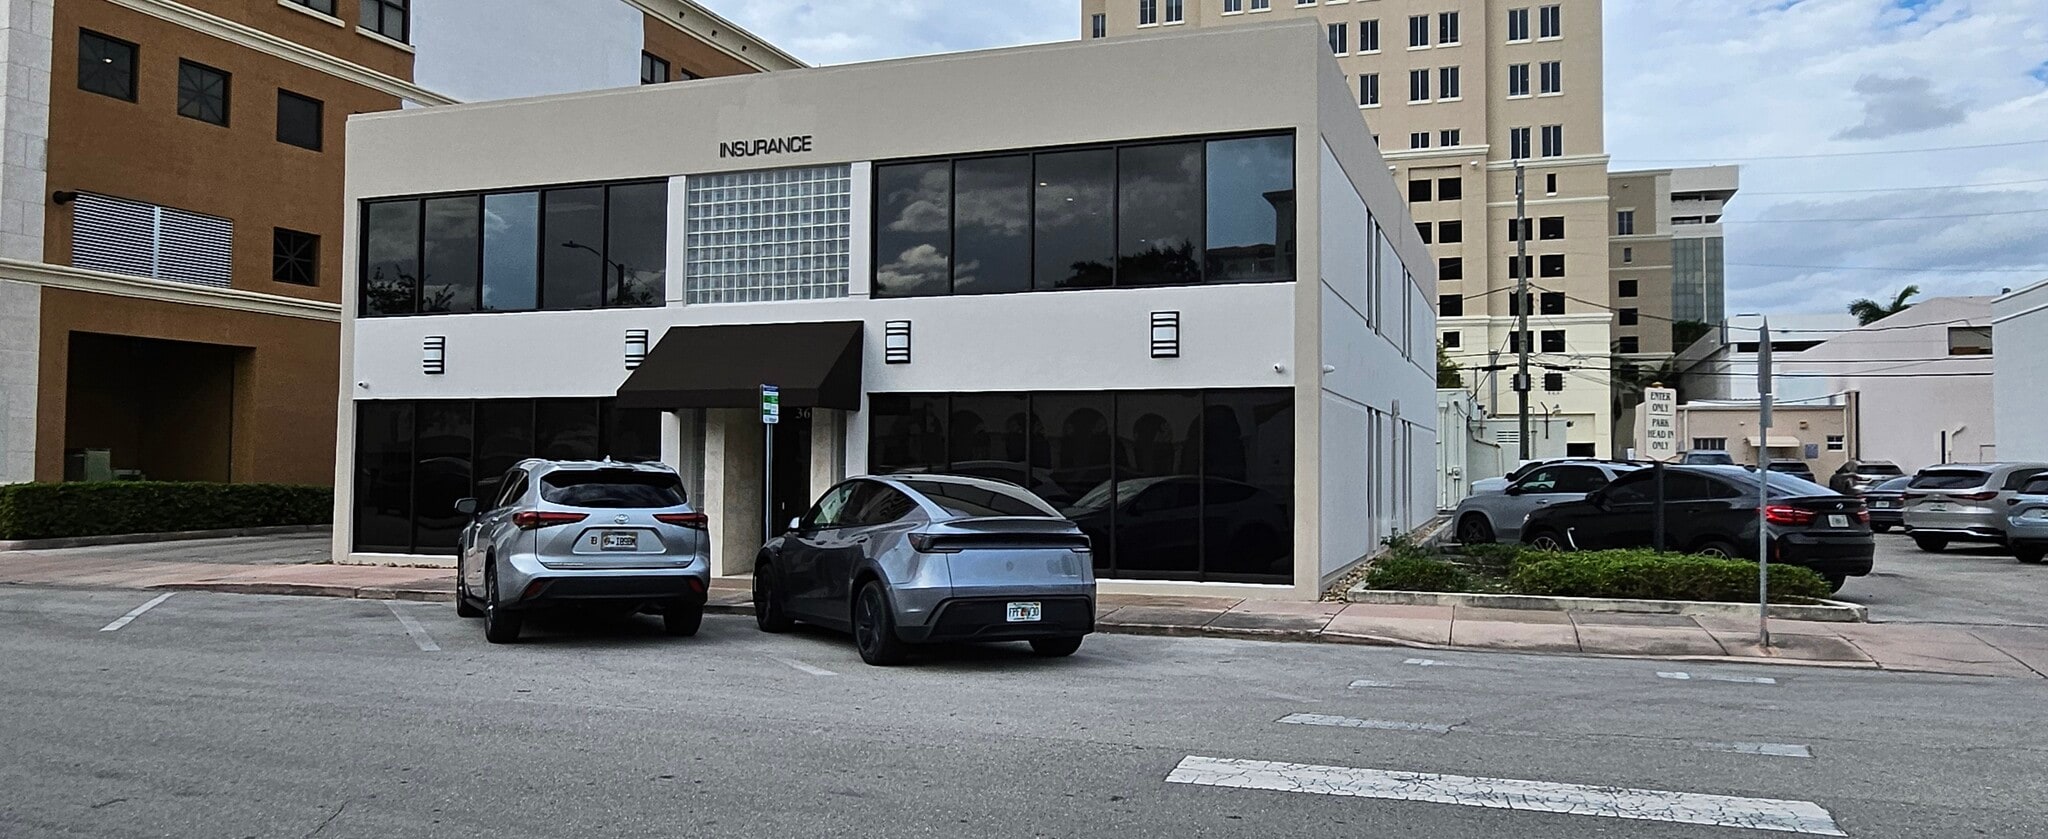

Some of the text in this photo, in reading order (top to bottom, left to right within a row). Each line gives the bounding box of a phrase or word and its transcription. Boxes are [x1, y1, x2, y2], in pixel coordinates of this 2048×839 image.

[719, 135, 813, 158] INSURANCE
[1650, 391, 1671, 401] ENTER
[1652, 403, 1669, 412] ONLY
[1652, 418, 1670, 427] PARK
[1647, 429, 1674, 438] HEAD IN
[1652, 441, 1669, 450] ONLY
